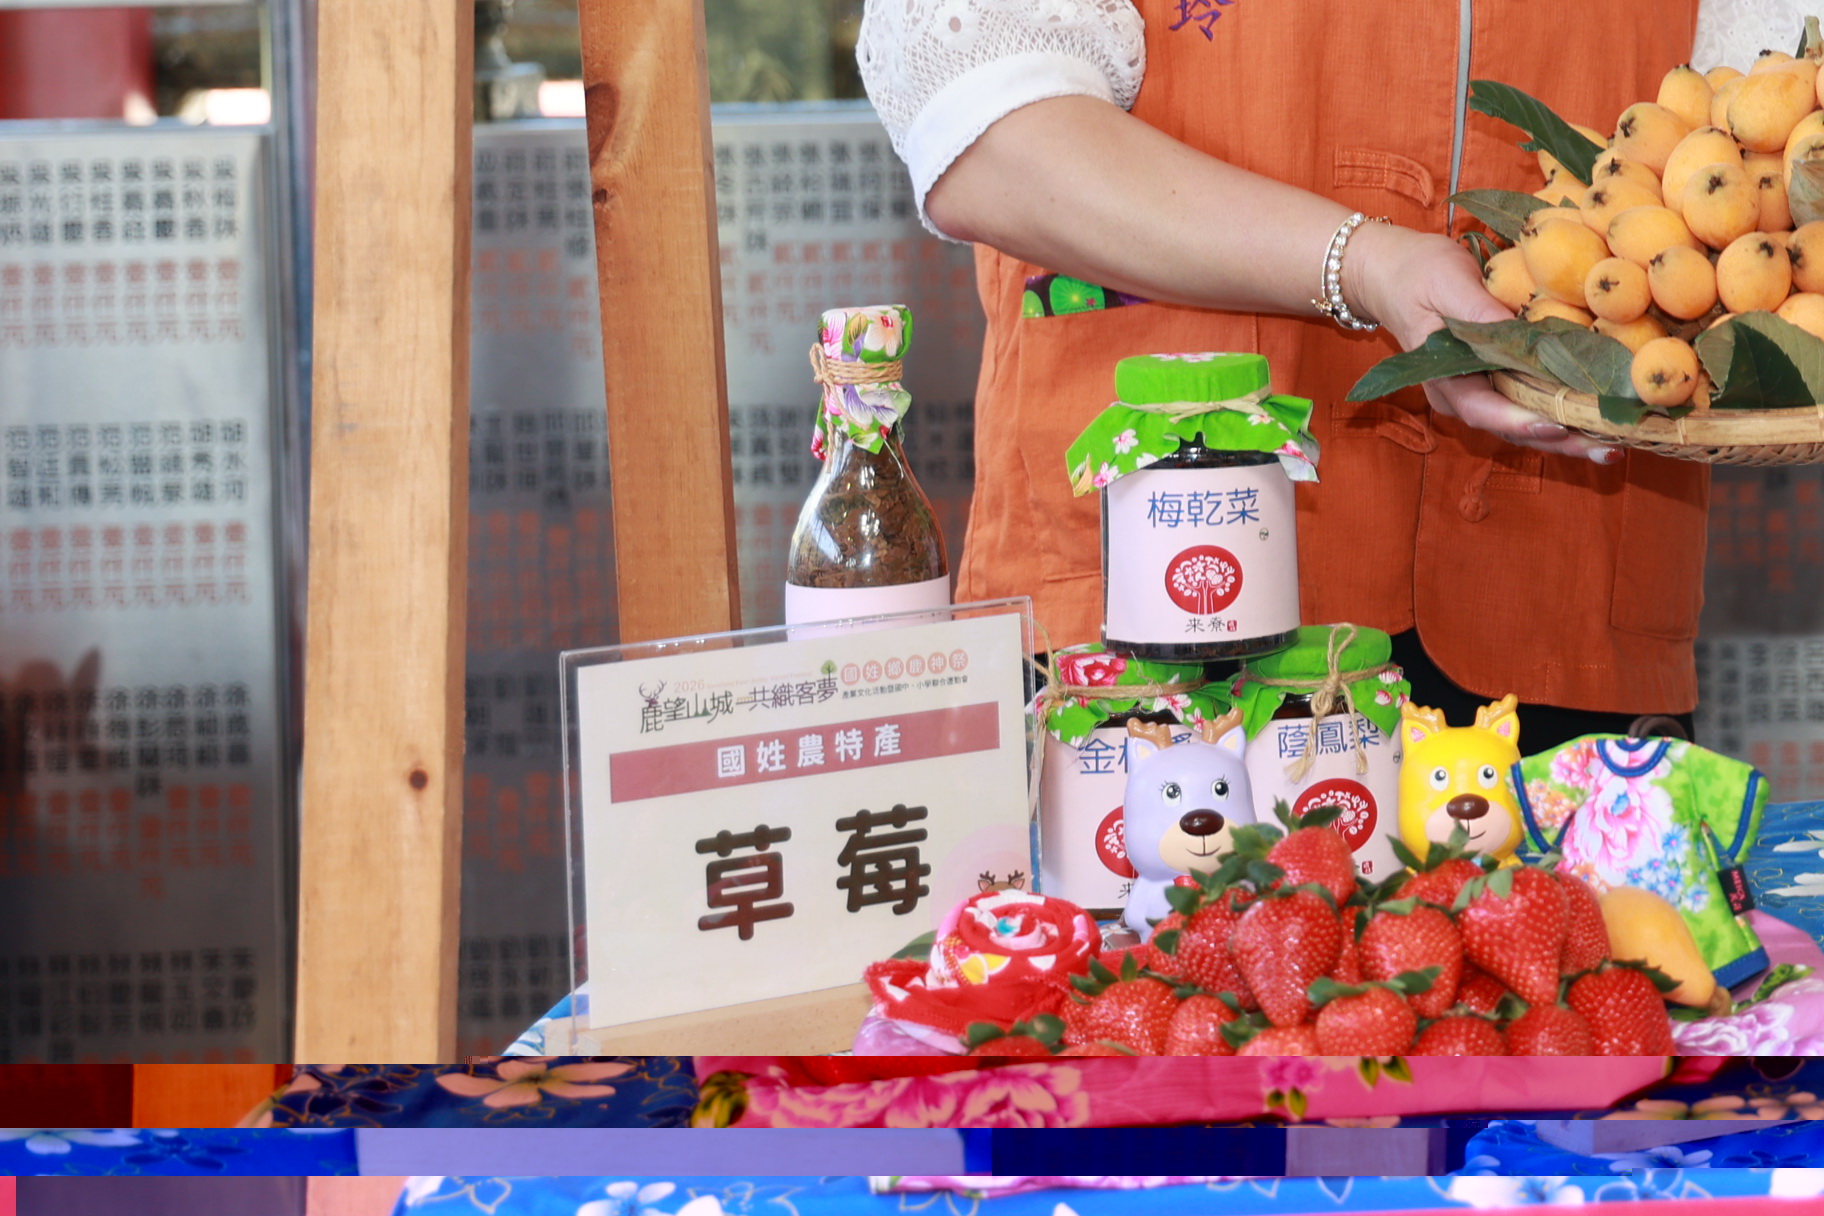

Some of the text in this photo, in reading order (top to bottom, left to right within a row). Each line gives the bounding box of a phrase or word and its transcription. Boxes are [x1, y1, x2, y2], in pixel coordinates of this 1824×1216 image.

[1147, 487, 1260, 528] 梅乾菜
[674, 679, 706, 694] 2026
[842, 649, 968, 685] 國姓鄉鹿神祭
[717, 723, 902, 778] 國姓農特產
[695, 803, 932, 941] 草莓
